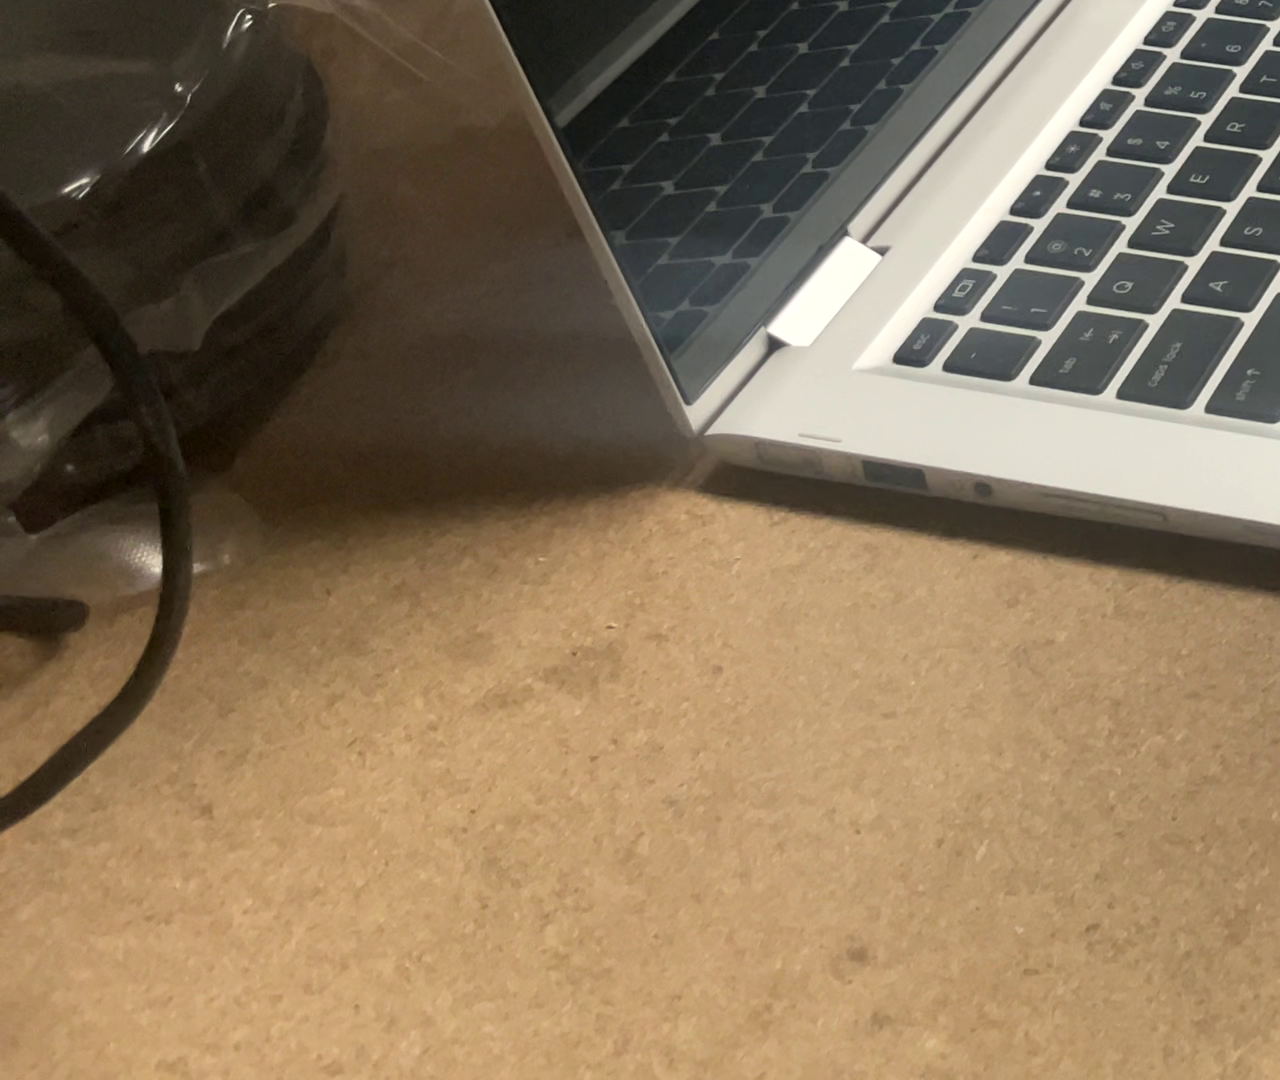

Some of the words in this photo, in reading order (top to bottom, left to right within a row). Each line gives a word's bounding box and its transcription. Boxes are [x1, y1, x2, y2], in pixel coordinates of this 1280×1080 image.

[1260, 75, 1277, 83] T
[1189, 91, 1207, 99] 5
[1226, 122, 1246, 132] R
[1156, 141, 1170, 149] 4
[1189, 174, 1210, 183] E
[1113, 193, 1132, 201] 3
[1151, 219, 1175, 235] W
[1244, 226, 1263, 236] S
[1075, 247, 1092, 257] 2
[1112, 281, 1134, 293] Q
[1208, 281, 1229, 292] A
